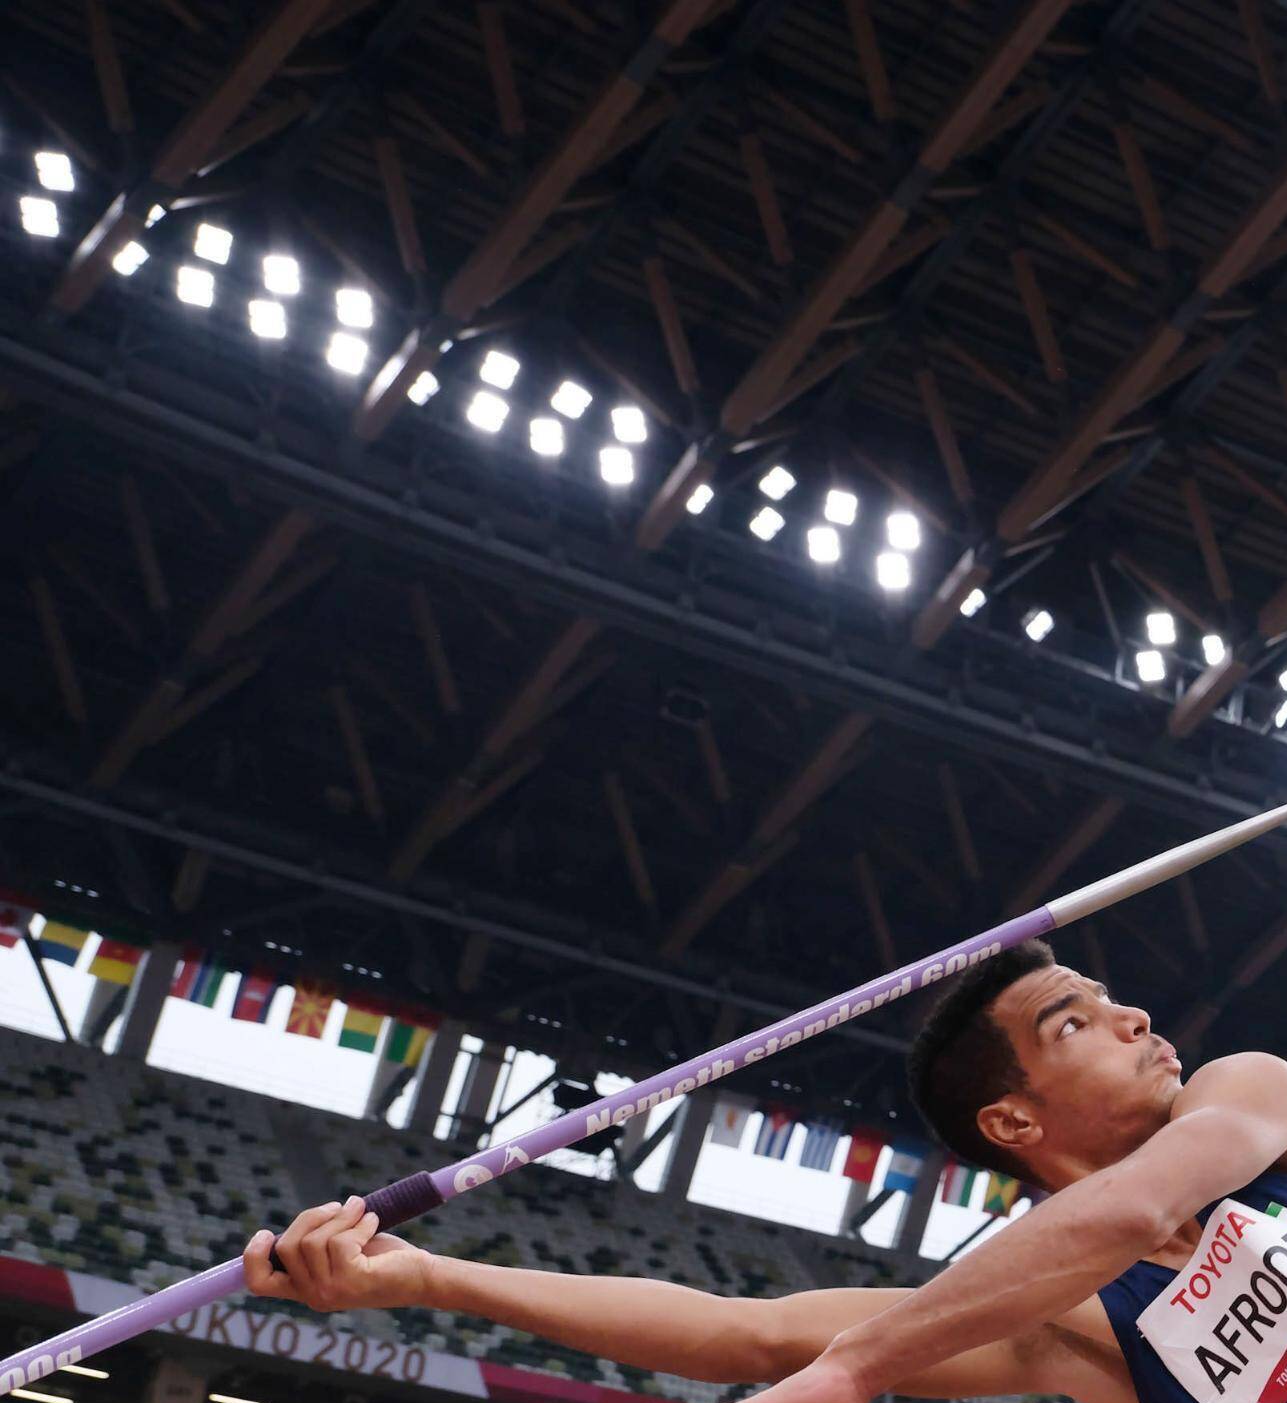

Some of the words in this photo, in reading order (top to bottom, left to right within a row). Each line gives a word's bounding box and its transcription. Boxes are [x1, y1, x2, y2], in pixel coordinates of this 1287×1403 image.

[587, 1057, 735, 1136] Nemeth
[1170, 1210, 1257, 1315] TOYOTA
[168, 1302, 299, 1358] OKYO
[311, 1327, 427, 1384] 2020
